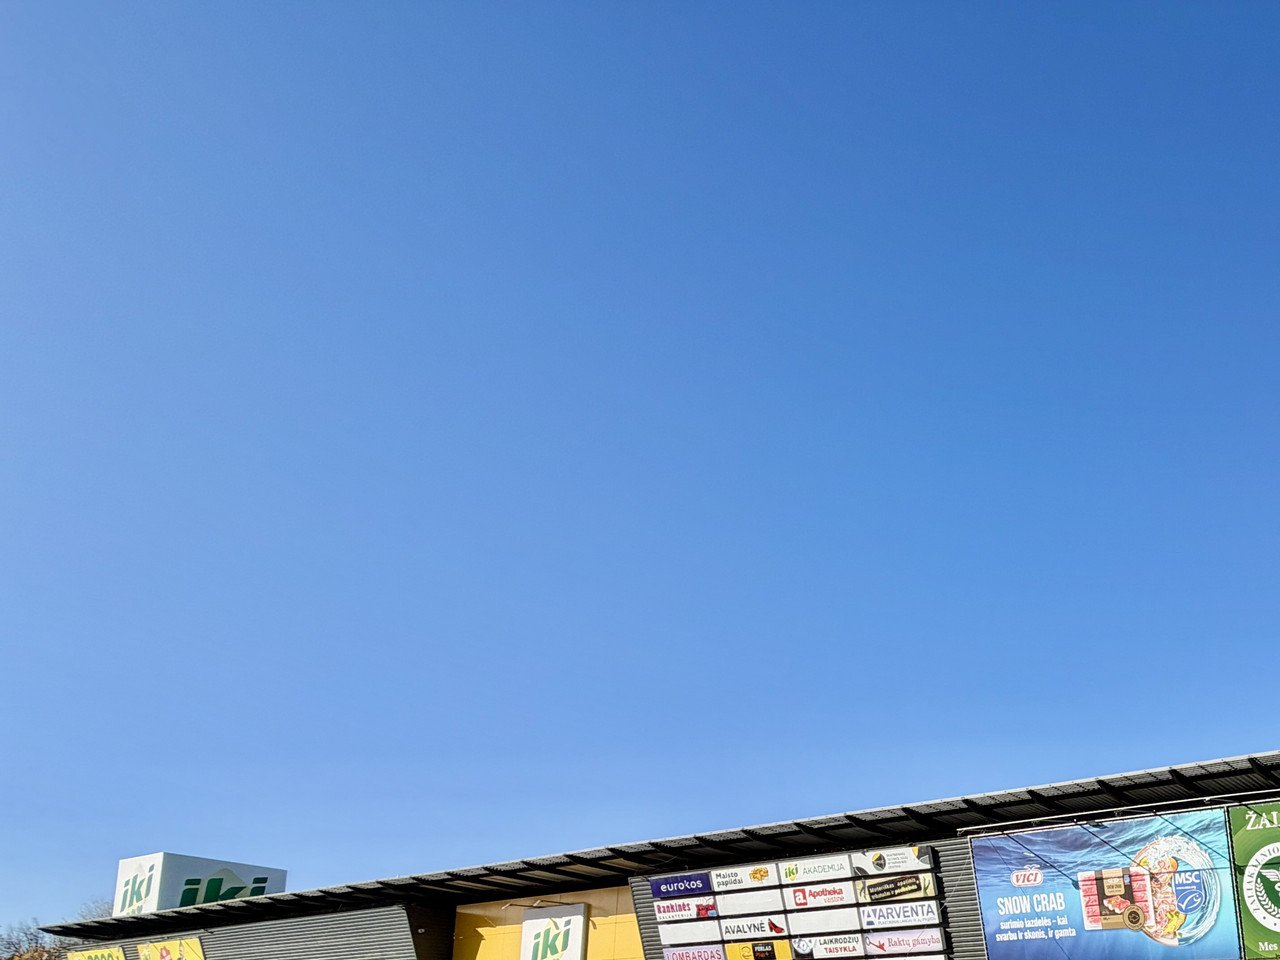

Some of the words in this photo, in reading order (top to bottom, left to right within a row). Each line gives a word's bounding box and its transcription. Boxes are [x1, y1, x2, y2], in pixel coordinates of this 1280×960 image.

[784, 862, 799, 879] iki
[802, 863, 846, 876] AKADEMIJA
[1015, 872, 1039, 884] VICI
[1175, 871, 1200, 885] MSC
[120, 863, 155, 913] iki
[660, 879, 703, 892] eurokos
[808, 887, 844, 900] Apotheka
[996, 894, 1031, 916] SNOW
[1033, 892, 1066, 912] CRAB
[877, 903, 936, 920] ARVENTA
[724, 920, 766, 935] AVALYNĖ
[911, 935, 941, 948] gamyba
[1258, 941, 1278, 951] Mes
[824, 946, 857, 954] TAISYKLA
